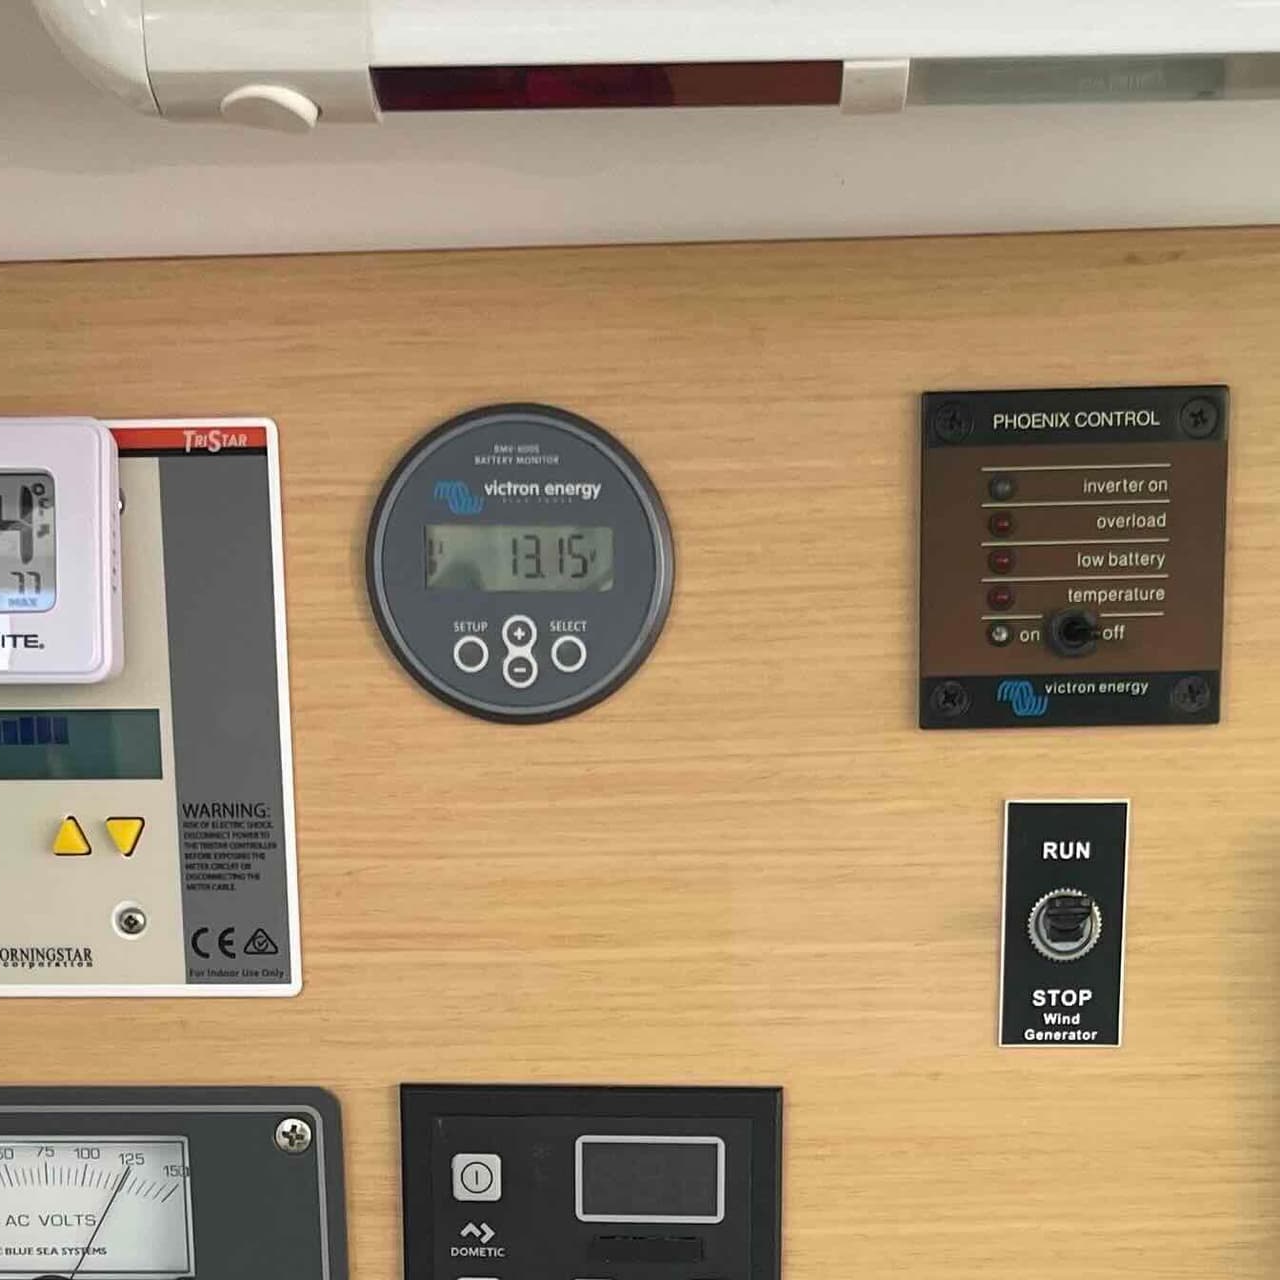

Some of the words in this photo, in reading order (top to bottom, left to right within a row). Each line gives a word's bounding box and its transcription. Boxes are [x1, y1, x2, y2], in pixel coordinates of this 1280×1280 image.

[993, 412, 1069, 430] PHOENIX
[1075, 410, 1160, 427] CONTROL
[474, 455, 513, 465] BATTERY
[516, 455, 560, 465] MONITOR
[484, 480, 540, 496] victron
[544, 482, 602, 501] energy
[1083, 479, 1146, 493] inverter
[1149, 480, 1168, 493] on
[1096, 513, 1166, 529] overload
[1077, 553, 1104, 568] low
[1109, 552, 1166, 570] battery
[1068, 587, 1166, 605] temperature
[453, 621, 488, 632] SETUP
[549, 621, 587, 632] SELECT
[1102, 624, 1126, 641] off
[1019, 627, 1040, 642] on
[1045, 681, 1095, 695] victron
[1099, 681, 1149, 696] energy
[183, 803, 271, 819] WARNING:
[1043, 842, 1090, 859] RUN
[207, 968, 239, 977] Indoor
[242, 968, 259, 977] Use
[261, 968, 284, 979] Only
[1033, 990, 1092, 1006] STOP
[1043, 1013, 1080, 1025] Wind
[1024, 1029, 1097, 1041] Generator
[36, 1146, 55, 1158] 75
[73, 1148, 101, 1160] 100
[119, 1153, 145, 1166] 125
[5, 1214, 30, 1227] AC
[38, 1214, 96, 1227] VOLTS
[4, 1247, 32, 1256] BLUE
[36, 1247, 59, 1256] SEA
[61, 1247, 108, 1256] SYSTEMS
[451, 1247, 505, 1258] DOMETIC
